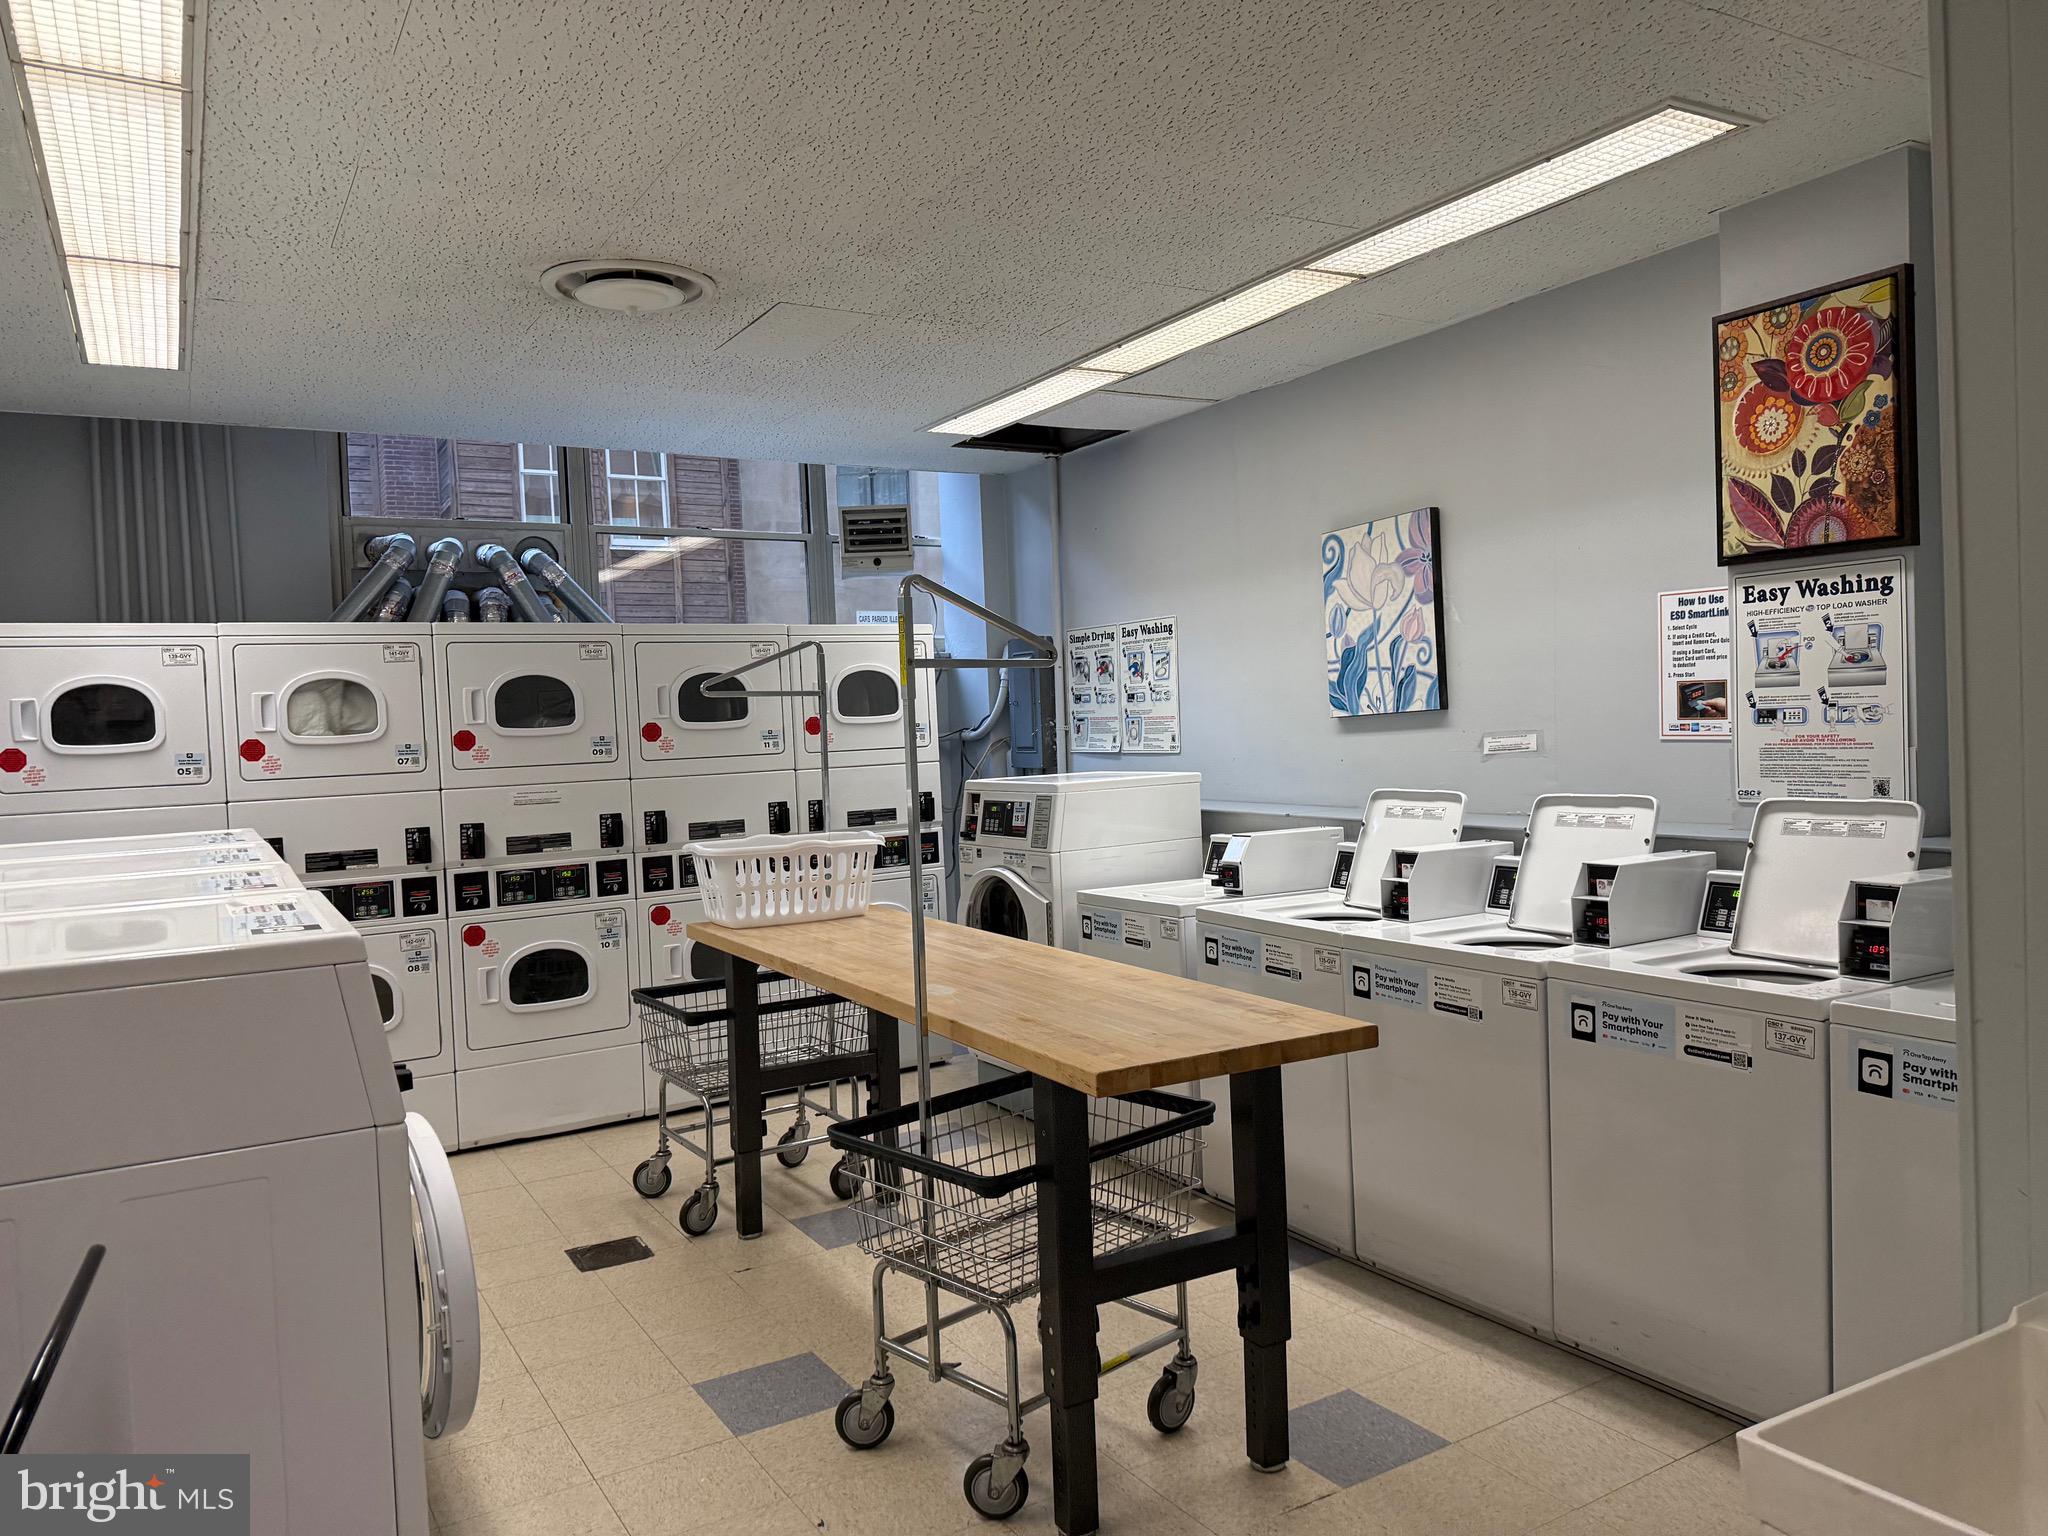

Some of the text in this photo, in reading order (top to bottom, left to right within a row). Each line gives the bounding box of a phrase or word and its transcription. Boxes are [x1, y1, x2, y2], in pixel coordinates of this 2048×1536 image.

[1742, 574, 1894, 606] Easy Washing
[1678, 594, 1724, 607] How to Use
[1670, 607, 1729, 620] ESD SmartLink
[1746, 605, 1805, 617] HIGH-EFFICIENCY
[1816, 602, 1831, 610] TOP
[1832, 601, 1853, 610] LOAD
[1855, 598, 1888, 608] WASHER
[871, 615, 889, 623] PARKED
[1121, 622, 1173, 639] Easy Washing
[1069, 633, 1090, 645] Simple
[1091, 631, 1115, 642] Drying
[592, 748, 604, 756] 09
[177, 767, 192, 775] 05
[600, 941, 610, 949] 10
[1221, 942, 1231, 951] Pay
[1242, 946, 1255, 954] Your
[1221, 949, 1252, 961] Smartphone
[407, 964, 420, 972] 08
[1374, 972, 1419, 989] Pay with Your
[1374, 980, 1416, 996] Smartphone
[1602, 1011, 1663, 1030] Pay with Your
[1602, 1021, 1659, 1039] Smartphone
[1774, 1032, 1807, 1045] 137-GVY
[1921, 1053, 1931, 1061] Tap
[1931, 1056, 1947, 1064] Away
[1903, 1061, 1957, 1080] Pay with
[1903, 1073, 1958, 1092] Smartph
